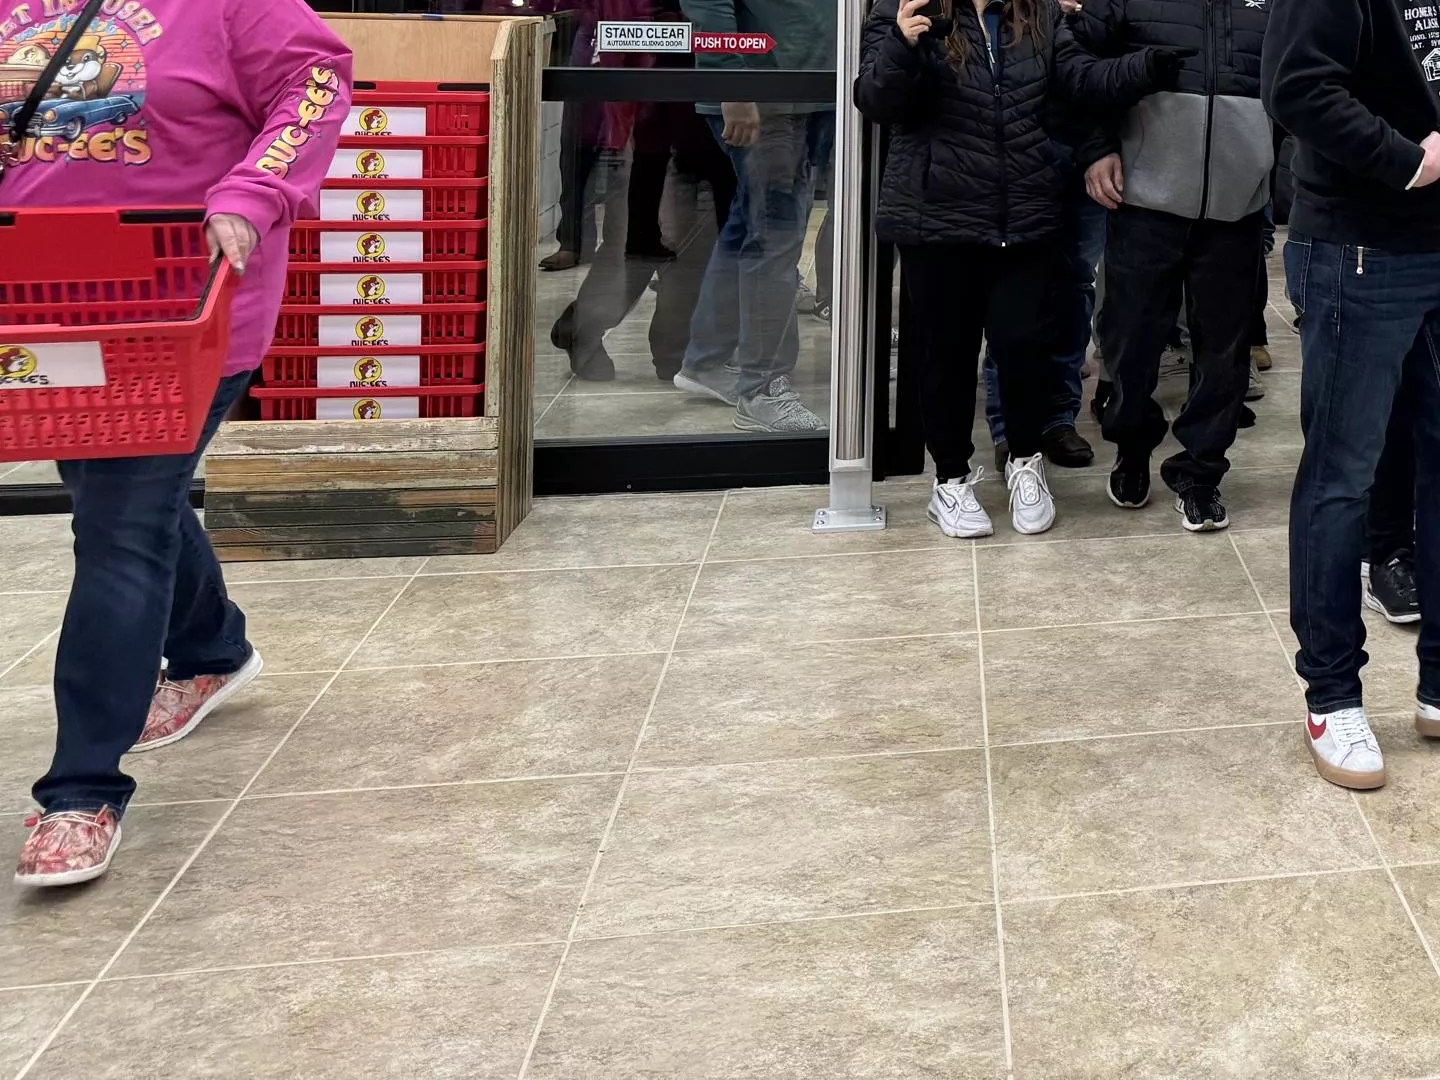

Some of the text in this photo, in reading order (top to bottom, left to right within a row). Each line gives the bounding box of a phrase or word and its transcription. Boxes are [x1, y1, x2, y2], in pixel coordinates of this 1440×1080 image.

[605, 27, 684, 39] STAND CLEAR
[694, 37, 767, 49] PUSH TO OPEN
